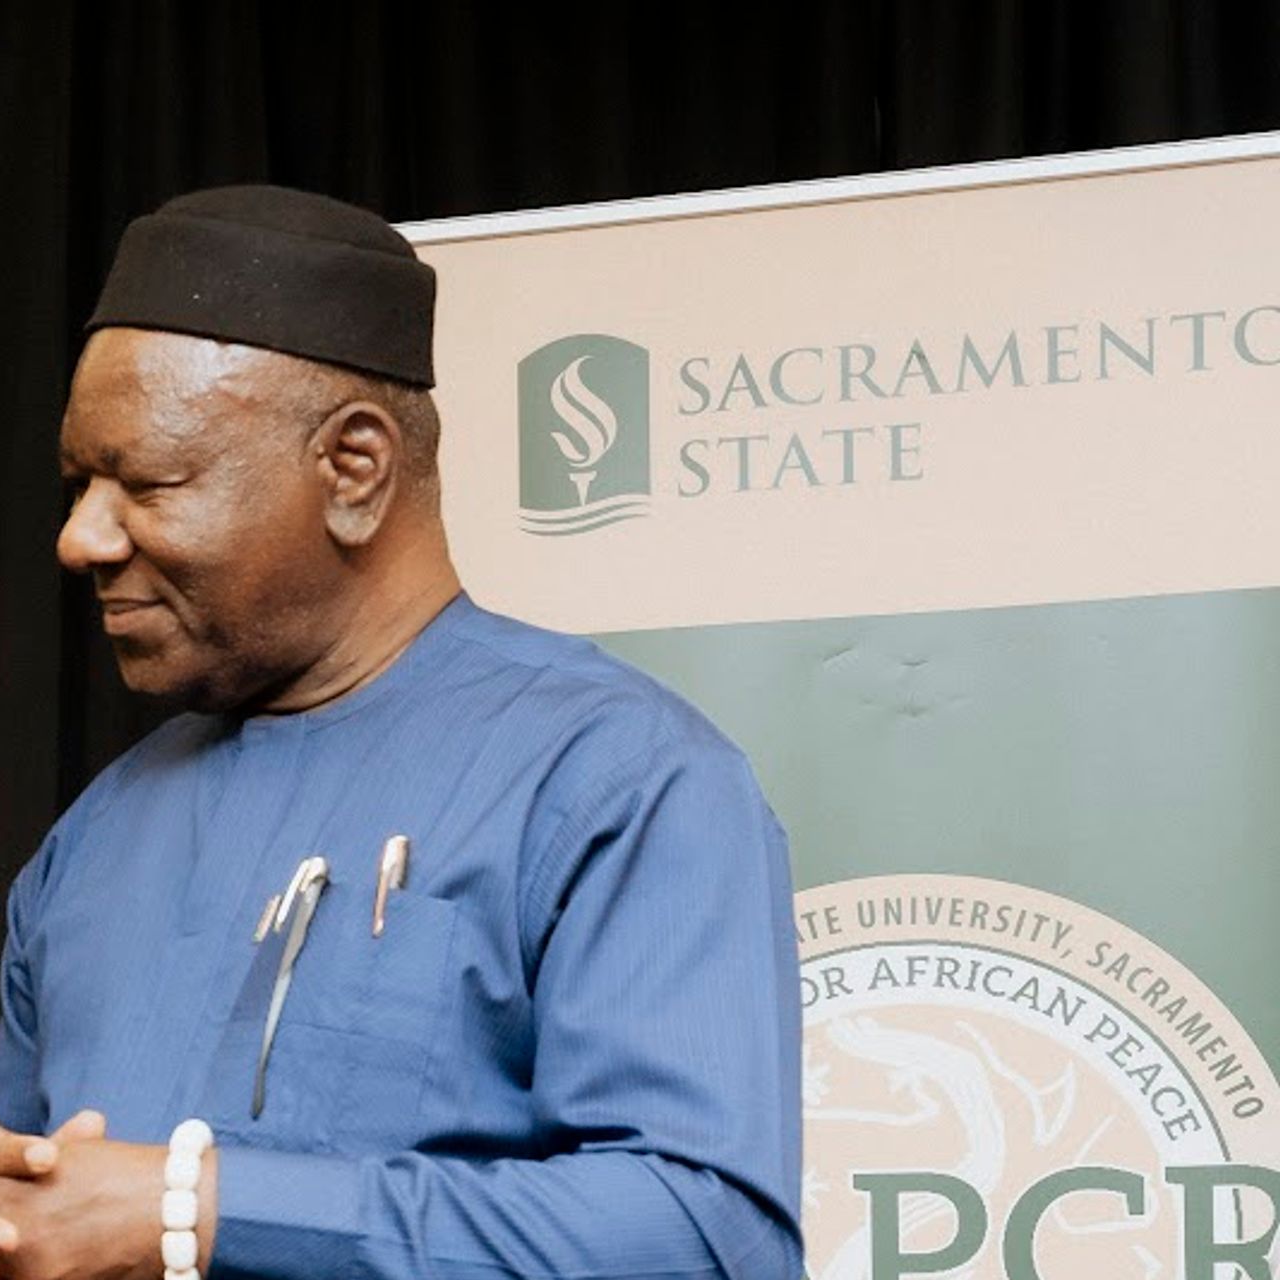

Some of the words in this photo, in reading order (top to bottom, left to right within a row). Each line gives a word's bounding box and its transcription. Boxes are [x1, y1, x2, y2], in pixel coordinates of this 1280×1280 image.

[677, 304, 1280, 415] SACRAMENTO
[677, 422, 925, 498] STATE
[856, 896, 1074, 960] UNIVERSITY,
[1086, 941, 1266, 1121] SACRAMENTO
[867, 954, 1086, 1028] AFRICAN
[1083, 1010, 1203, 1143] PEACE
